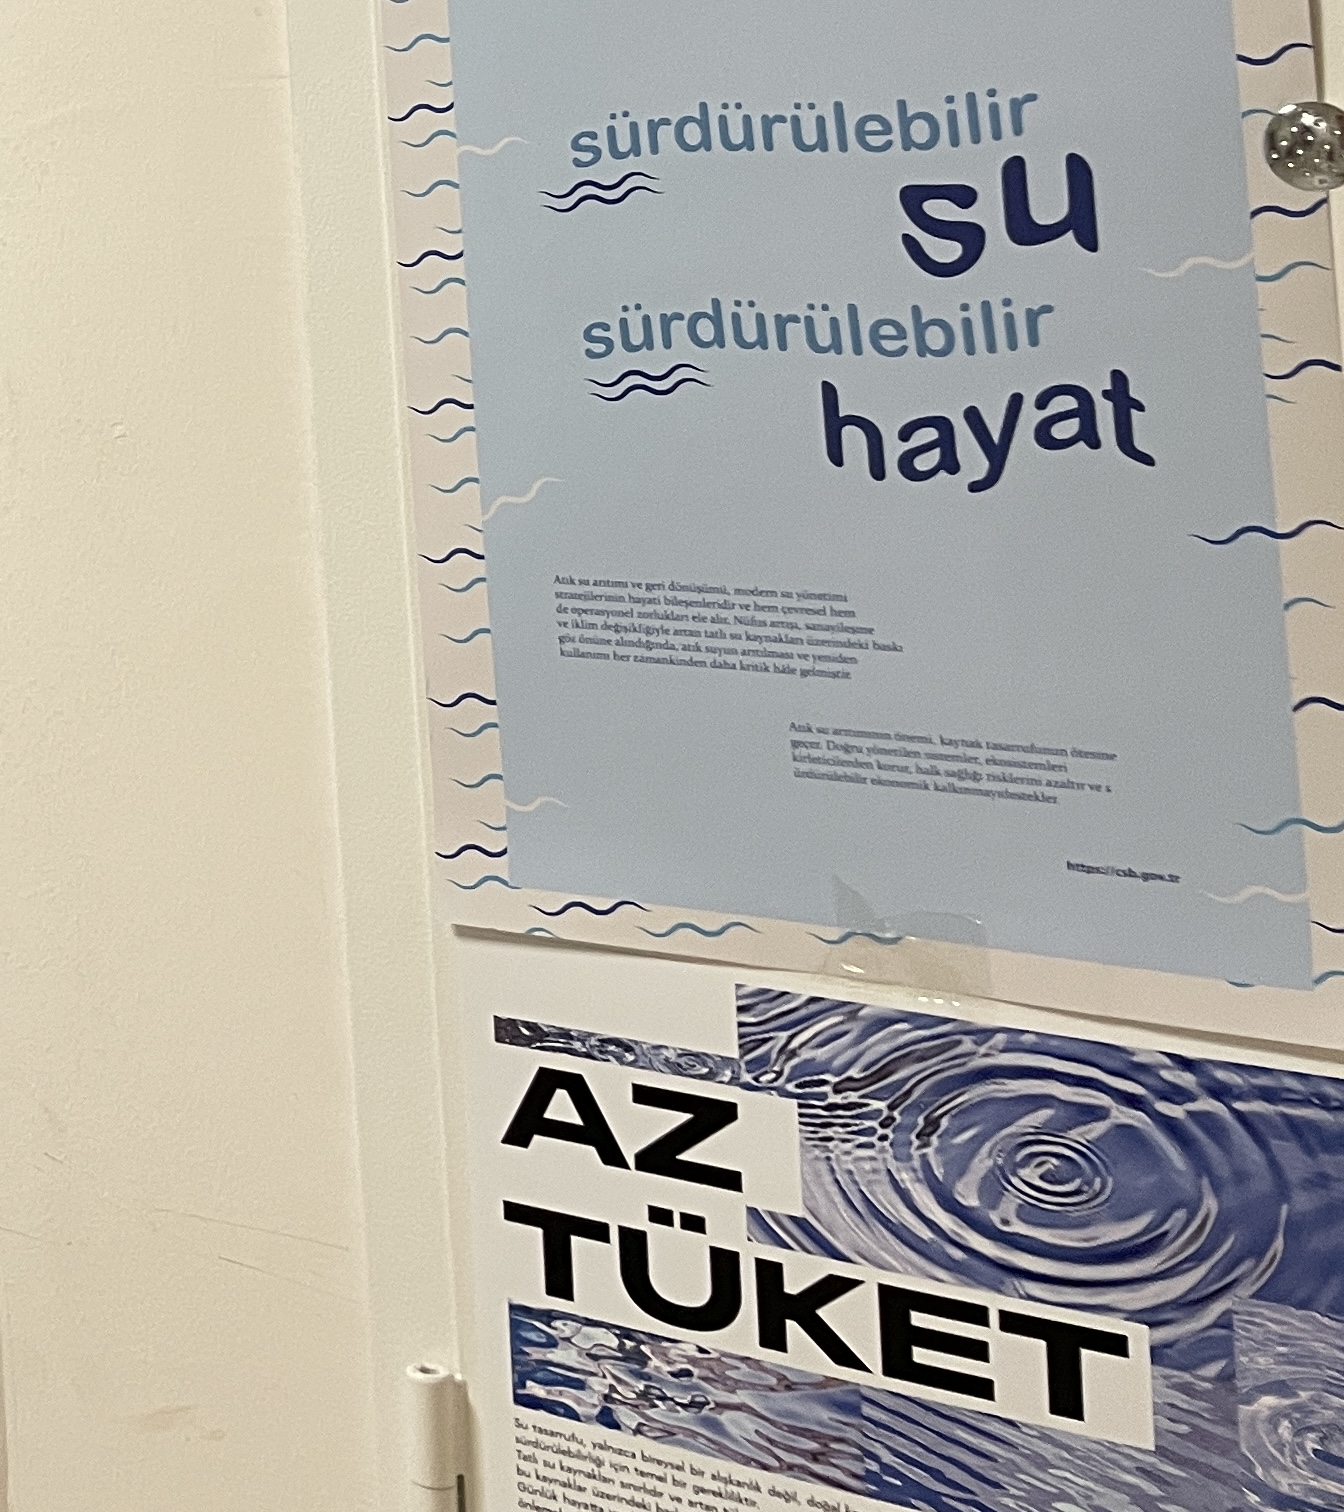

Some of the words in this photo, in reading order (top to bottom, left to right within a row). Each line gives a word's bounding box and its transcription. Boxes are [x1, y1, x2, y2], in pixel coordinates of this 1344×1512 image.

[570, 88, 1038, 168] sürdürülebilir
[898, 151, 1099, 278] su
[582, 297, 1054, 360] sürdürülebilir
[820, 368, 1156, 494] hayat
[500, 1065, 744, 1194] AZ
[502, 1199, 1131, 1424] TÜKET
[514, 1417, 529, 1430] Su
[689, 1462, 705, 1478] bir
